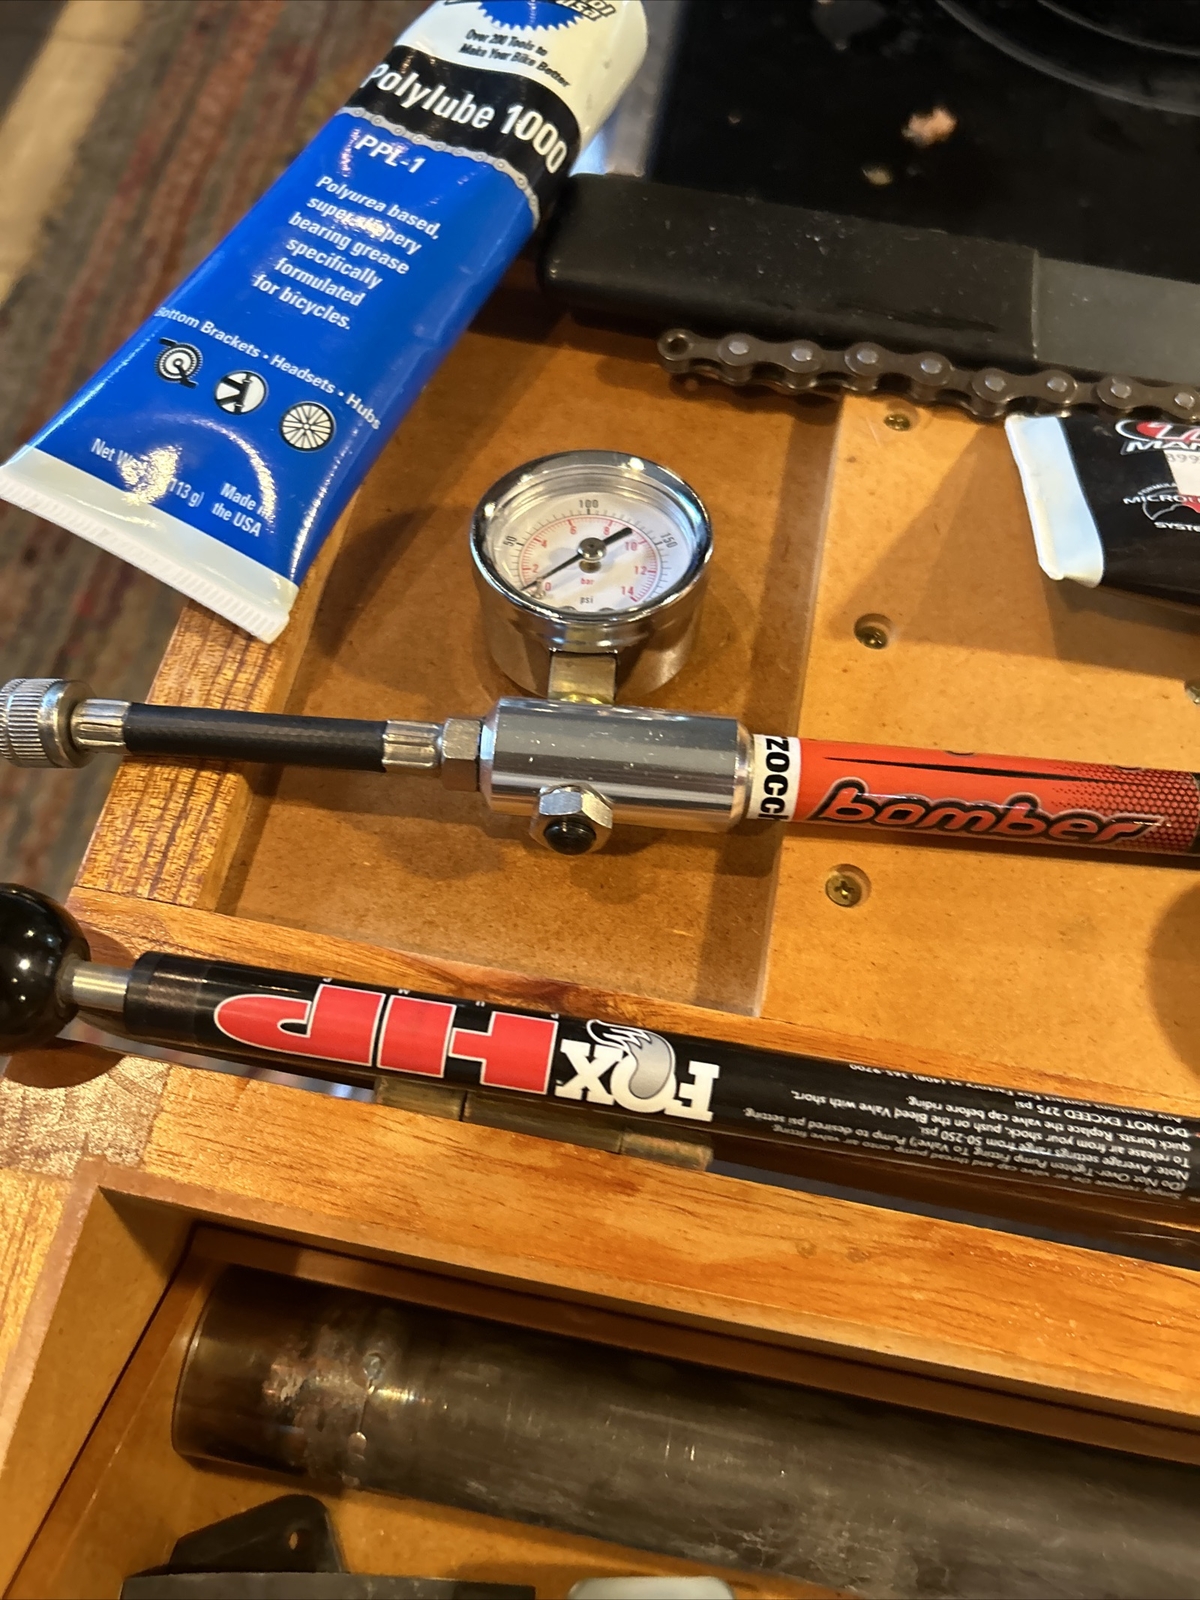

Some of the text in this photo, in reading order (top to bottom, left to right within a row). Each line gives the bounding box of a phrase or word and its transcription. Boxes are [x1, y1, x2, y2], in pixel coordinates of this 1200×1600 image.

[360, 63, 567, 173] Polylube 1000
[354, 134, 426, 174] PPL-1
[315, 175, 441, 239] Polyurea based,
[288, 212, 410, 275] bearing grease
[285, 238, 383, 290] specifically
[274, 257, 366, 307] formulated
[252, 273, 351, 330] for bicycles.
[200, 321, 261, 358] Brackets
[270, 354, 335, 395] Headsets
[347, 393, 382, 430] Hubs
[91, 438, 116, 462] Net
[220, 482, 257, 511] Made
[579, 499, 599, 509] 100
[211, 502, 262, 537] the USA
[1153, 521, 1200, 533] SYSTE
[503, 532, 678, 549] 50 150
[625, 541, 638, 551] 10
[532, 563, 648, 576] 2 12
[545, 581, 634, 596] 0 14
[580, 577, 595, 585] bar
[580, 595, 594, 604] psi
[758, 735, 789, 820] ZOCC
[806, 776, 1166, 844] bomber
[555, 1019, 719, 1122] FOX
[828, 1097, 856, 1111] with
[857, 1102, 893, 1118] Valve
[904, 1094, 943, 1112] riding.
[892, 1106, 929, 1124] Bleed
[944, 1103, 986, 1119] before
[986, 1109, 1009, 1122] cap
[1013, 1098, 1190, 1138] DO NOT EXCEED 275 psi
[787, 1115, 806, 1127] psi
[807, 1120, 853, 1135] desired
[930, 1114, 952, 1127] the
[953, 1118, 970, 1129] on
[972, 1119, 1002, 1136] push
[1010, 1114, 1042, 1129] valve
[1043, 1120, 1064, 1132] the
[809, 1132, 840, 1143] valve
[854, 1128, 870, 1138] to
[871, 1129, 906, 1144] Pump
[939, 1129, 982, 1146] 50-250
[1044, 1131, 1075, 1146] your
[1065, 1122, 1114, 1141] Replace
[893, 1145, 928, 1157] pump
[952, 1145, 970, 1155] To
[984, 1137, 1016, 1151] from
[1075, 1138, 1106, 1153] from
[1108, 1144, 1125, 1156] air
[1157, 1137, 1192, 1155] quick
[929, 1151, 969, 1164] thread
[972, 1146, 1011, 1162] Fitting
[1012, 1154, 1047, 1168] Pump
[1053, 1146, 1100, 1164] settings
[1126, 1147, 1170, 1164] release
[1171, 1155, 1191, 1168] To
[971, 1159, 994, 1169] and
[996, 1162, 1017, 1172] cap
[1100, 1154, 1152, 1174] Average
[1132, 1174, 1159, 1187] Not
[1159, 1177, 1186, 1192] (Do
